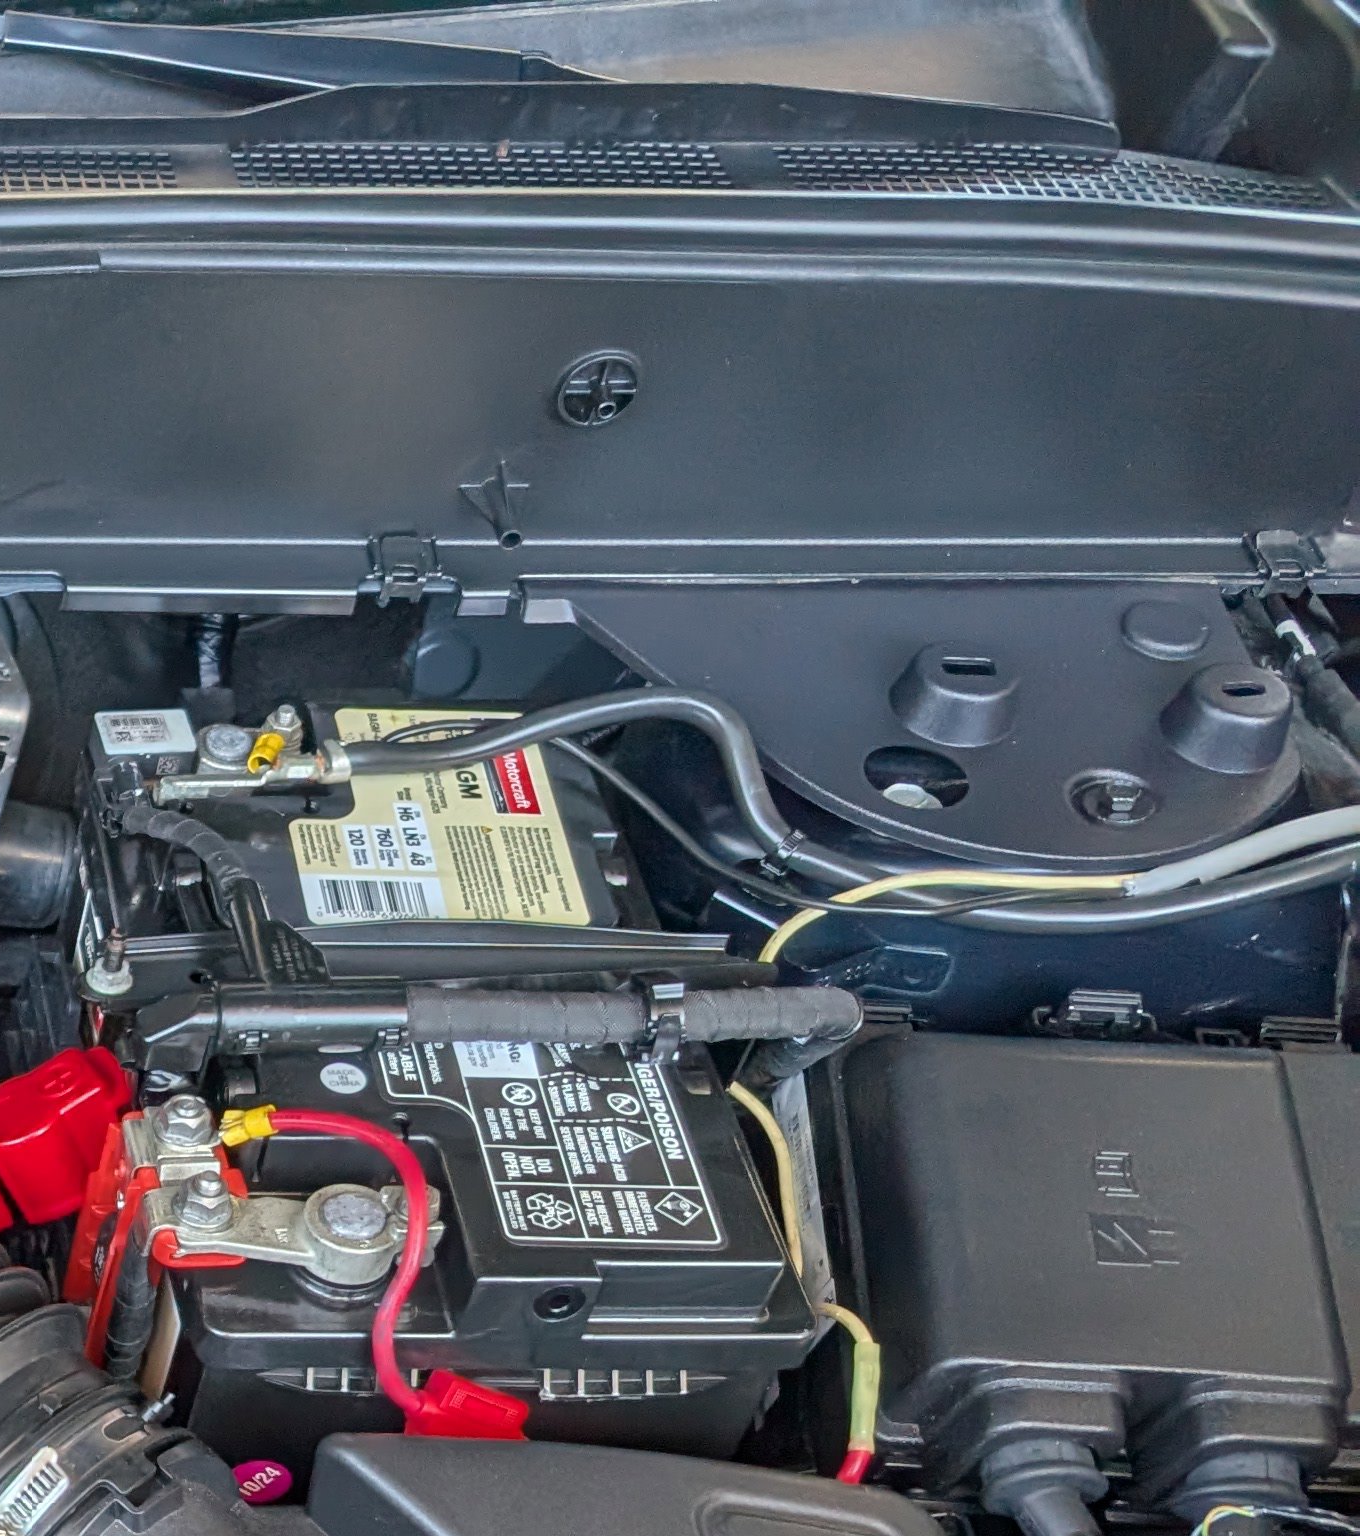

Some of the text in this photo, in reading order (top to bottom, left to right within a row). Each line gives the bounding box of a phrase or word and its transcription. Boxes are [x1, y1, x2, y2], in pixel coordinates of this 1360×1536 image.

[454, 768, 482, 798] GM
[346, 829, 365, 846] 120
[374, 828, 394, 847] 760
[396, 806, 426, 866] H6 LN3 48
[383, 1051, 400, 1075] attery
[546, 1085, 565, 1116] SMOKING
[560, 1083, 578, 1113] FLAMES
[574, 1082, 592, 1112] SPARKS
[633, 1062, 684, 1159] GER/POISON
[498, 1107, 517, 1139] REACH OF
[512, 1107, 529, 1131] OF THE
[527, 1108, 546, 1139] KEEP OUT
[558, 1126, 575, 1151] SEVERE
[572, 1126, 596, 1174] BLINDNESS OR
[586, 1126, 606, 1163] CAN CAUSE
[599, 1125, 628, 1181] SULFURIC ACID
[500, 1151, 522, 1180] OPEN.
[518, 1155, 537, 1175] NOT
[534, 1157, 553, 1173] DO
[508, 1189, 523, 1214] BATTERY
[578, 1190, 593, 1207] HELP
[590, 1190, 614, 1234] GET MEDICAL
[611, 1190, 626, 1208] WITH
[623, 1190, 647, 1235] IMMEDIATELY
[635, 1191, 657, 1231] FLUSH EYES
[238, 1466, 282, 1496] 10/24
